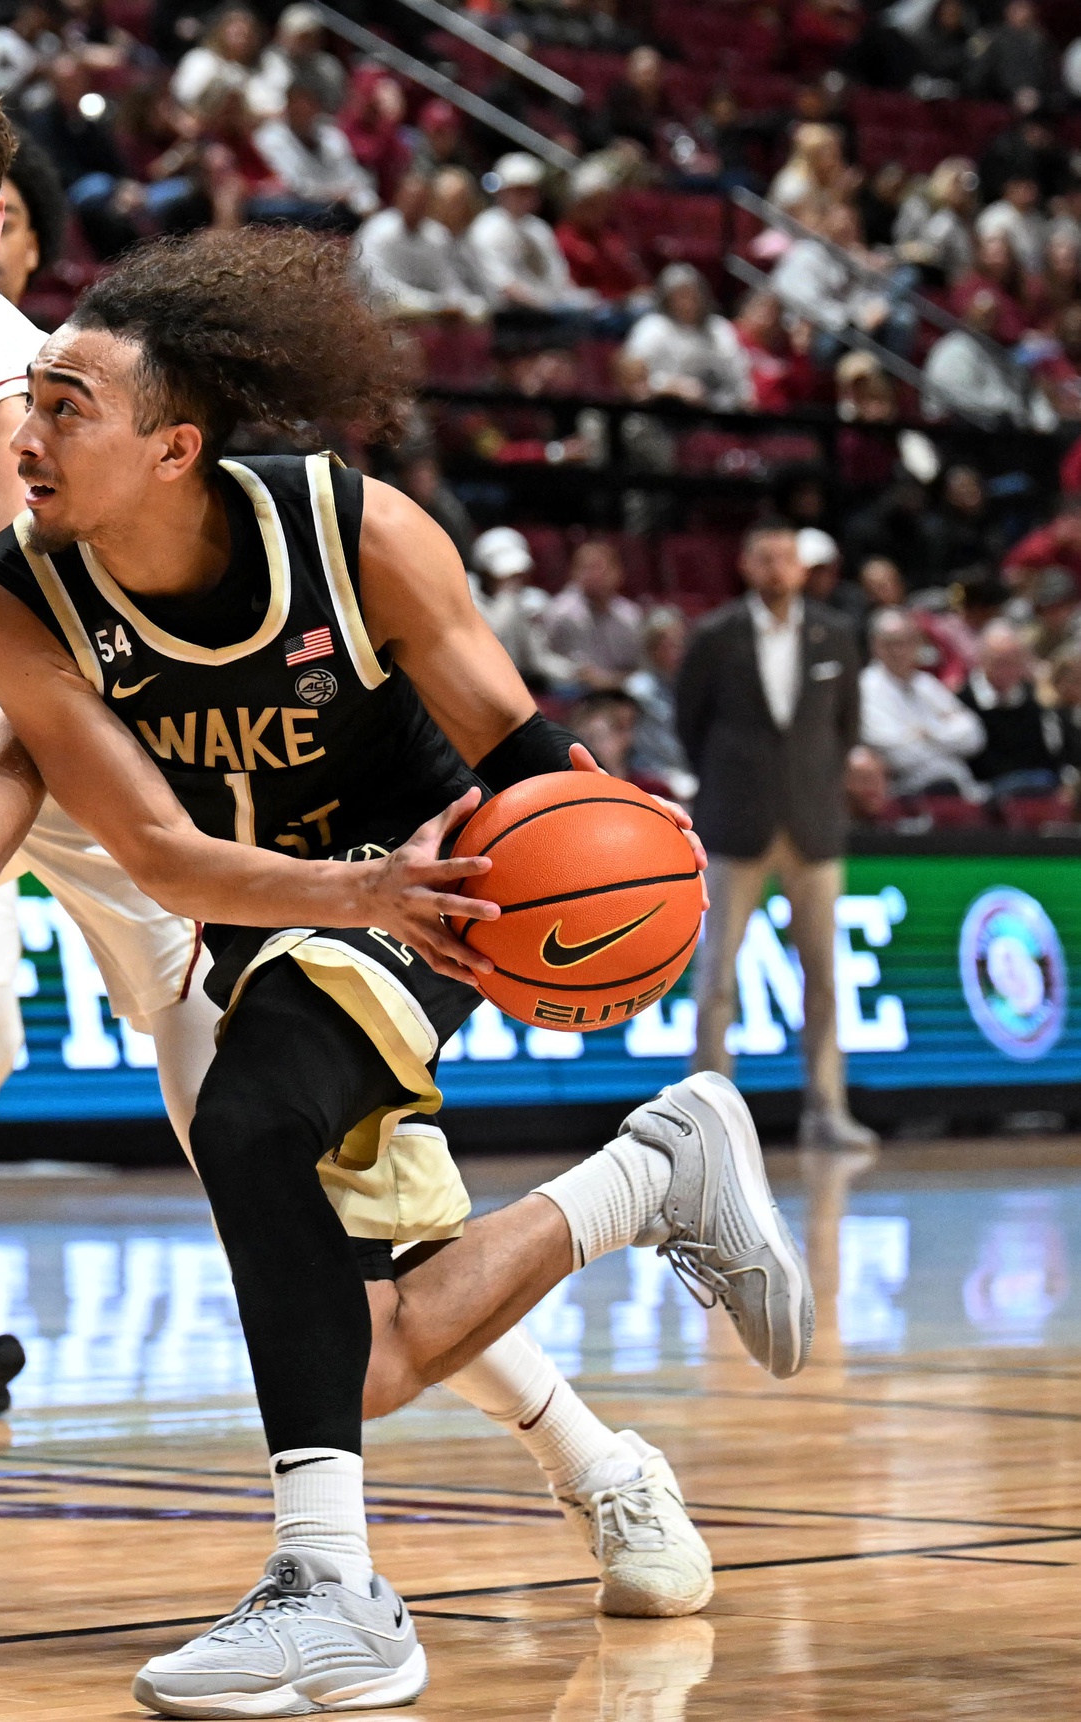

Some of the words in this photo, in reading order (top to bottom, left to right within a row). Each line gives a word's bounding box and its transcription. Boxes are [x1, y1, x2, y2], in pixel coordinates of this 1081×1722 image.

[94, 623, 133, 664] 54
[301, 679, 332, 691] ACC
[135, 706, 327, 771] WAKE
[223, 772, 257, 847] 1
[532, 978, 668, 1024] ELITE
